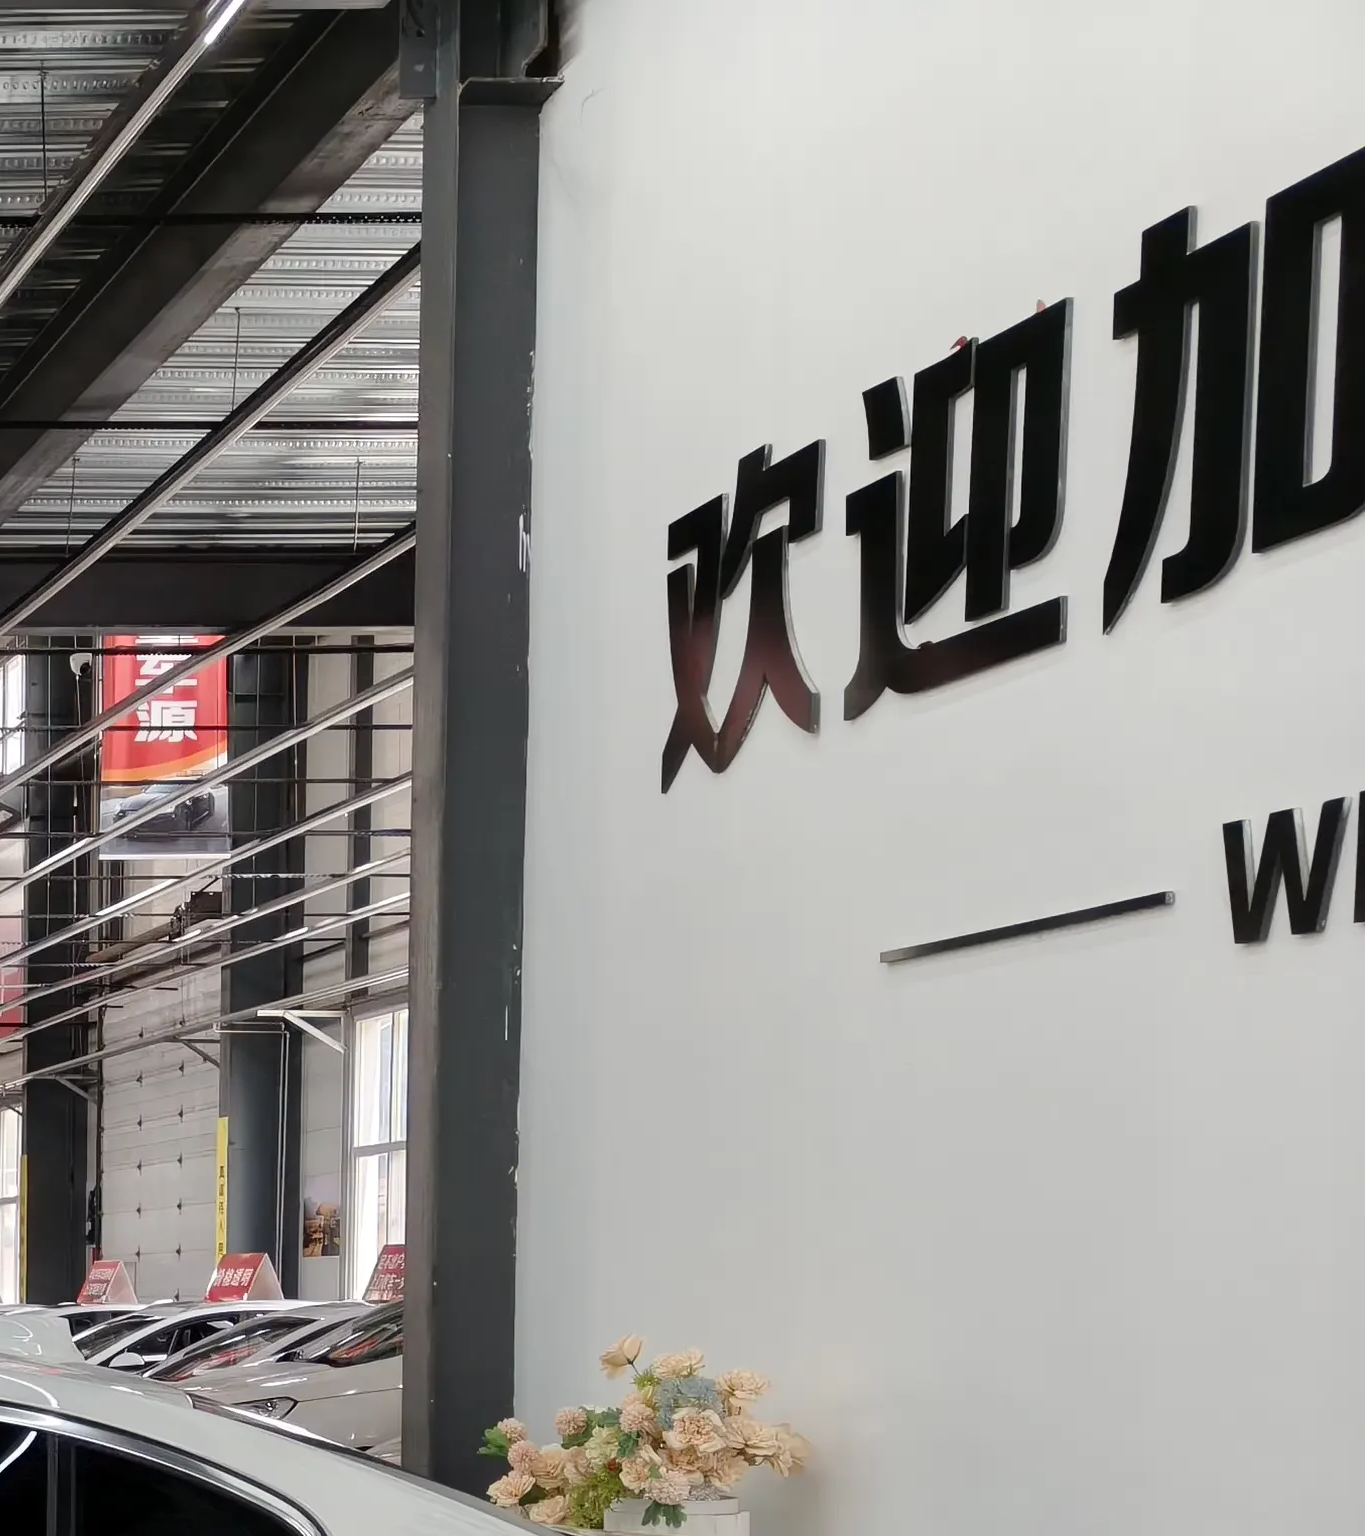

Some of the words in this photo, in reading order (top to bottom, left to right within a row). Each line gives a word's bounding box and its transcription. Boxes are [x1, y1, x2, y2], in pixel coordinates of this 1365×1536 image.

[660, 146, 1365, 796] 欢迎加
[134, 636, 198, 742] 车源
[1223, 788, 1365, 945] W
